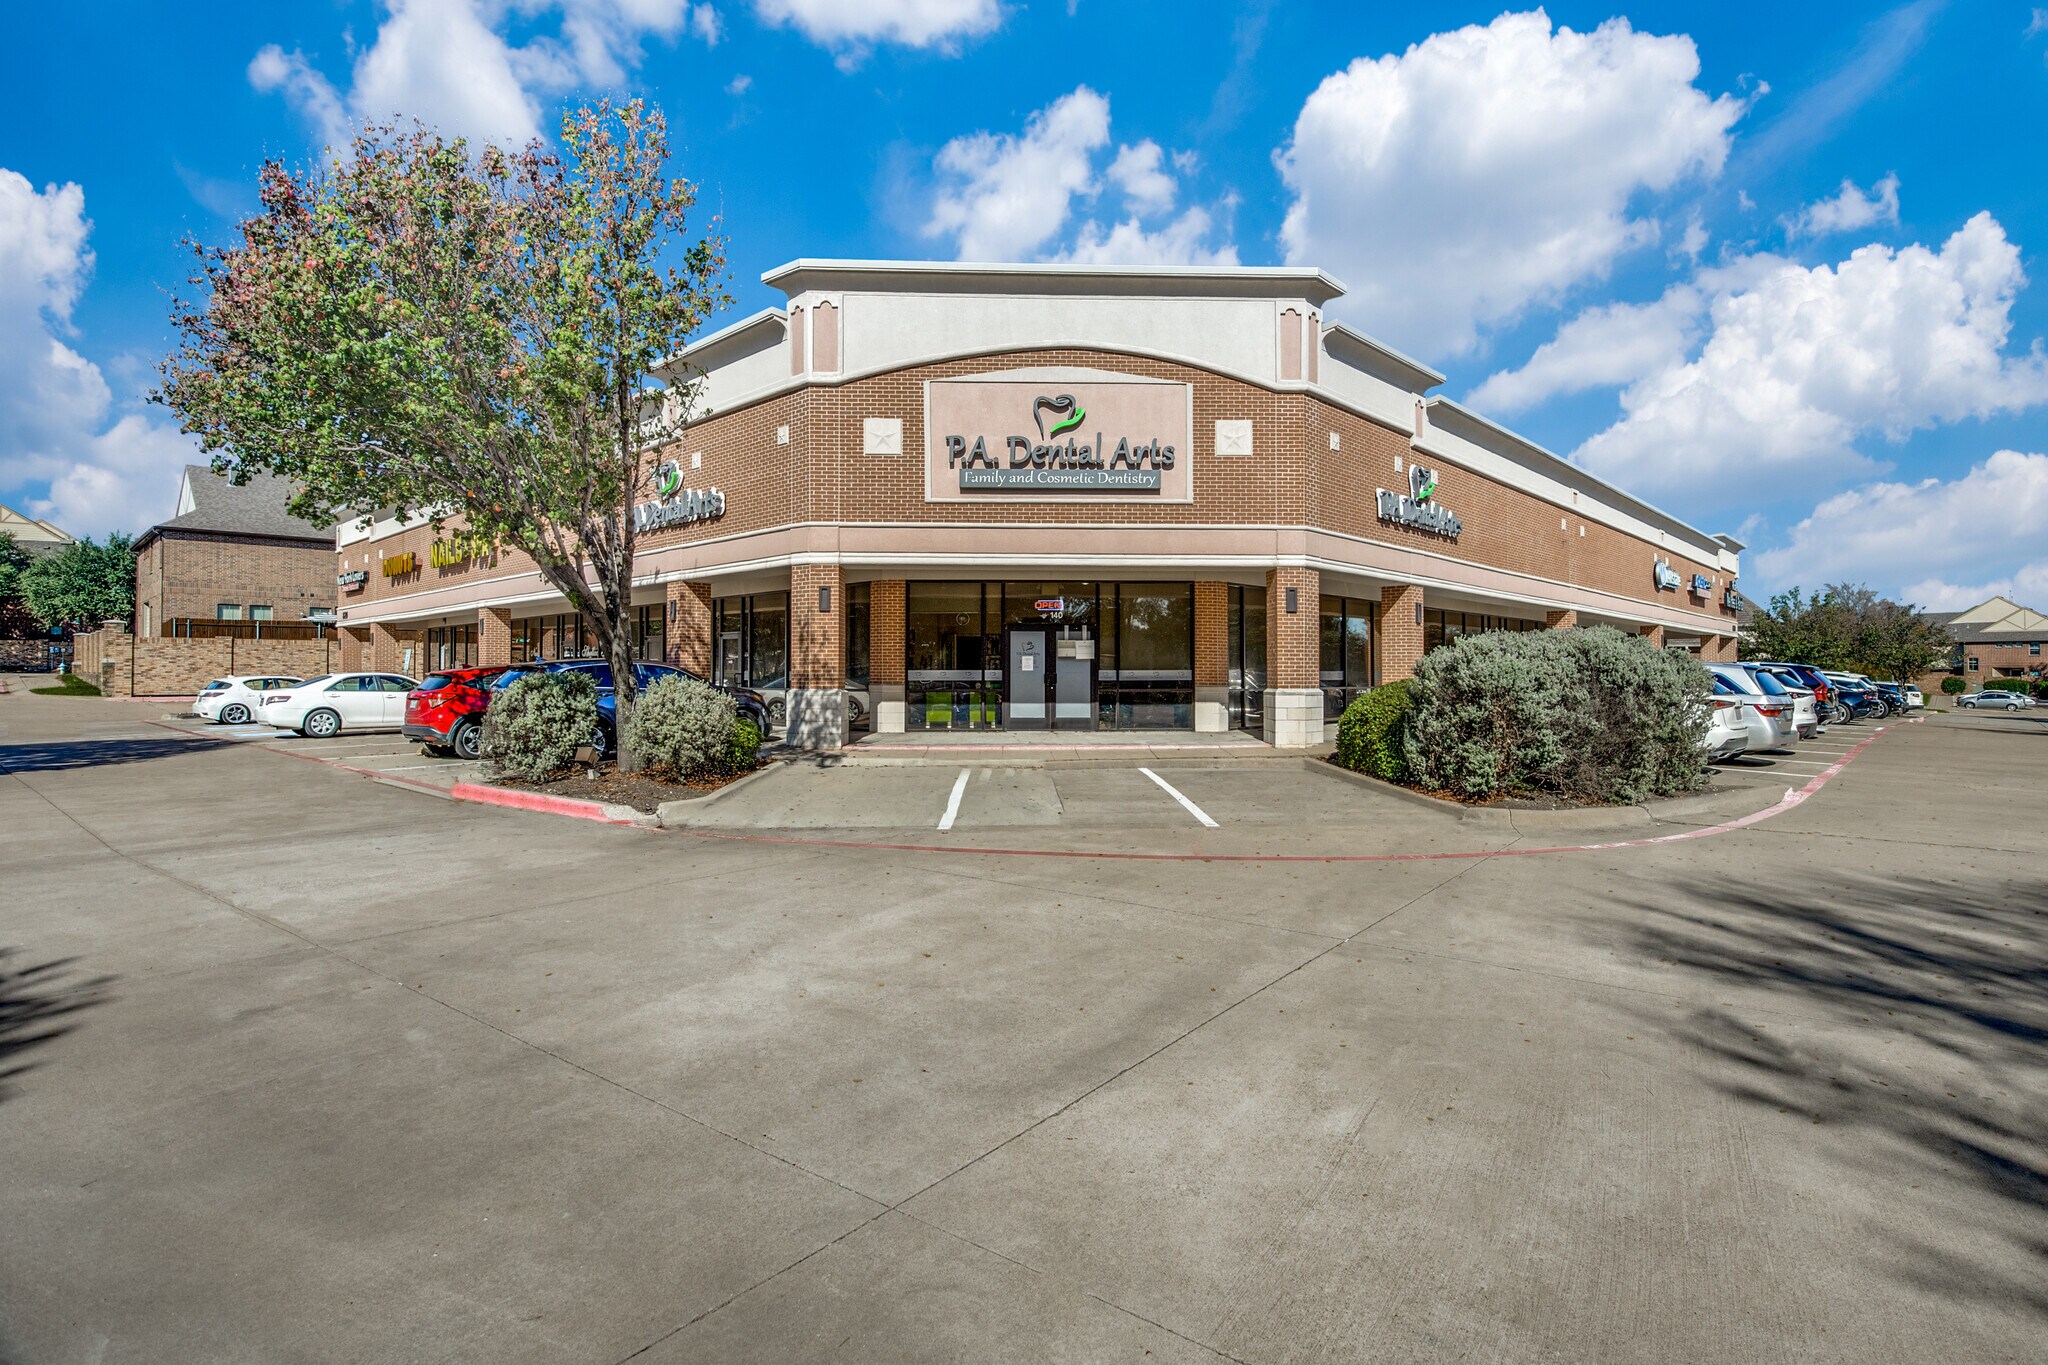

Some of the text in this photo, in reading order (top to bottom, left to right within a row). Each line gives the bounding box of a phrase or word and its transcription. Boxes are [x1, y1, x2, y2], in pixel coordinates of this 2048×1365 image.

[945, 431, 1176, 465] P.A. Dental Arts
[964, 470, 1157, 488] Family and Cosmetic Dentistry
[383, 552, 413, 577] DONUTS
[430, 536, 463, 568] NAILS
[1034, 601, 1062, 609] OPEN
